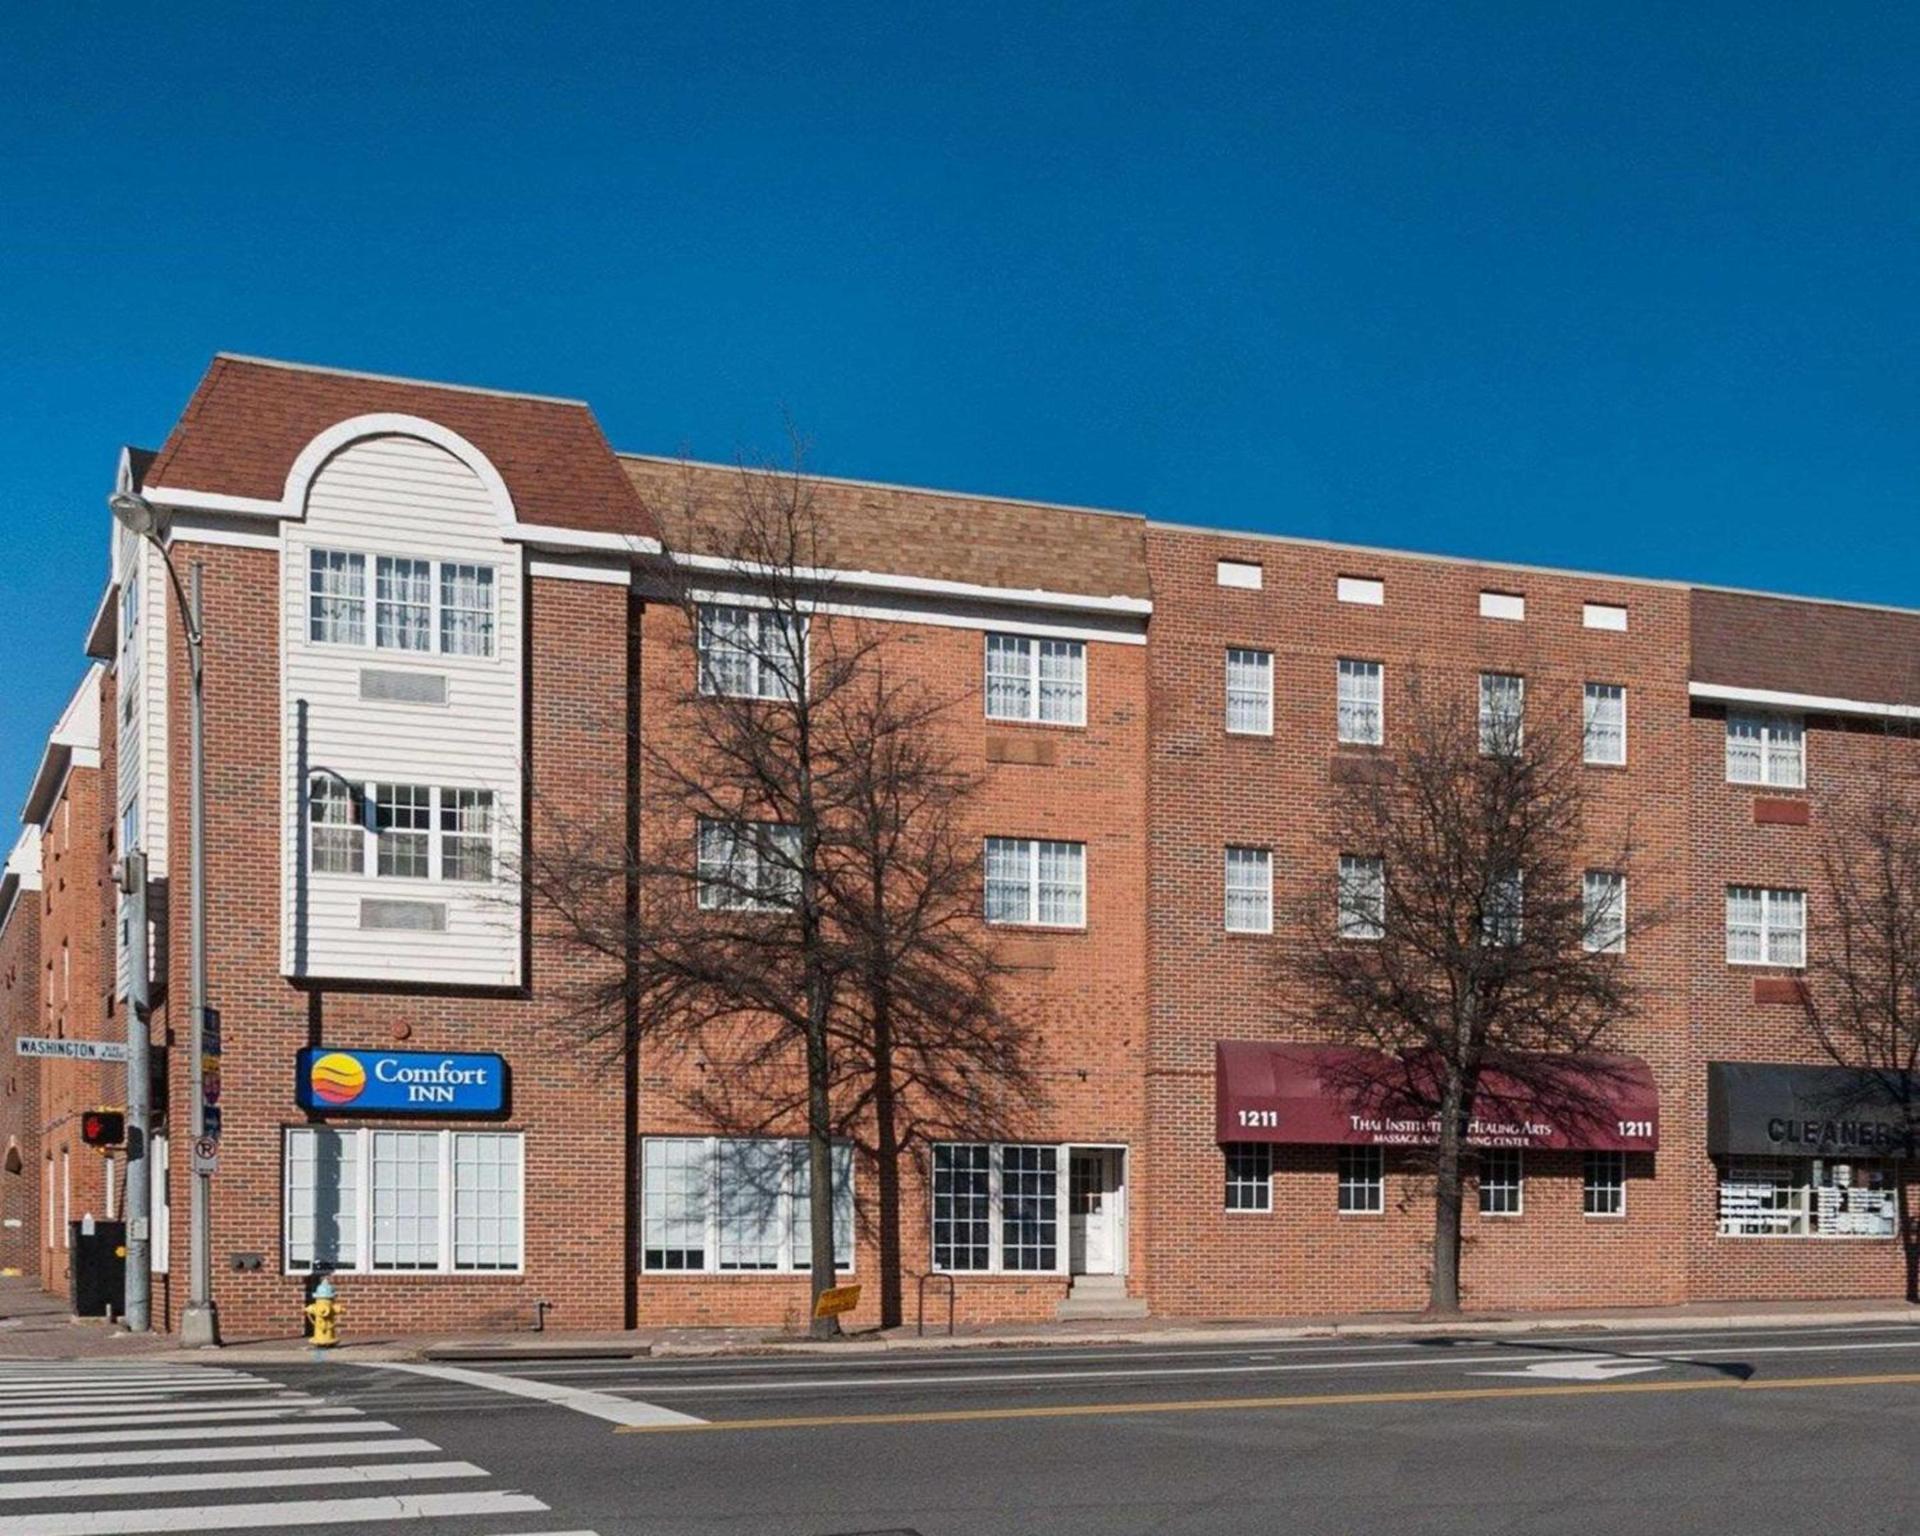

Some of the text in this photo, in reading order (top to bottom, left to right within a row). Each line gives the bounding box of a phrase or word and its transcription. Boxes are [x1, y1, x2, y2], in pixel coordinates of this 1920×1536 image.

[21, 1041, 95, 1056] WASHINGTON
[375, 1059, 487, 1084] Comfort
[409, 1086, 455, 1102] INN
[1238, 1110, 1277, 1127] 1211
[1618, 1121, 1652, 1137] 1211
